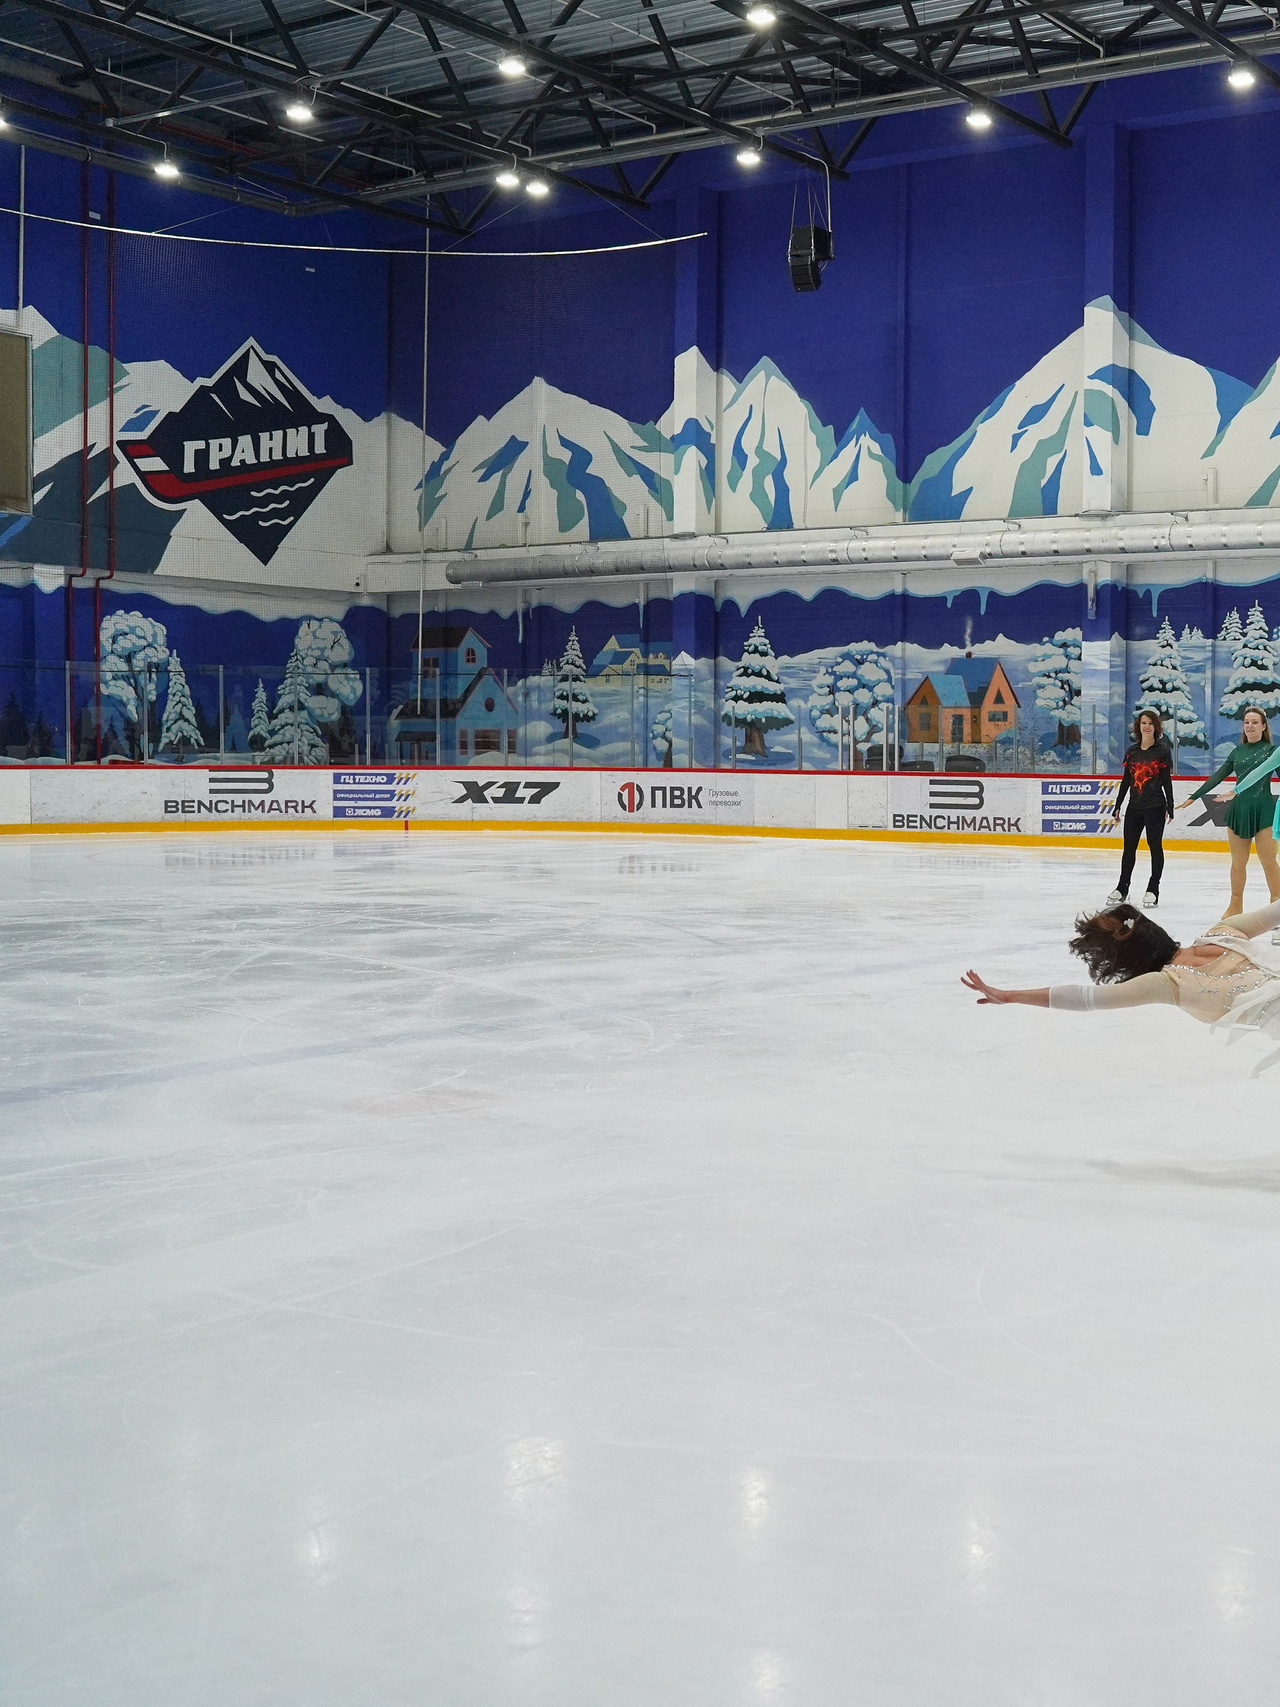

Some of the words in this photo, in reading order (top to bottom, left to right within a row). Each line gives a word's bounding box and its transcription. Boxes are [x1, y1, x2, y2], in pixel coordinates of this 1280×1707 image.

[182, 422, 329, 474] ГРАНИТ
[340, 775, 354, 784] ГЦ
[354, 775, 388, 783] ТЕХНО
[451, 780, 561, 804] X17
[708, 788, 739, 798] Грузовые
[1048, 784, 1060, 794] ГЦ
[1061, 784, 1092, 793] ТЕХНО
[650, 786, 703, 809] ПВК
[708, 800, 741, 808] перевозки
[164, 799, 317, 814] BENCHMARK
[893, 813, 1022, 833] BENCHMARK
